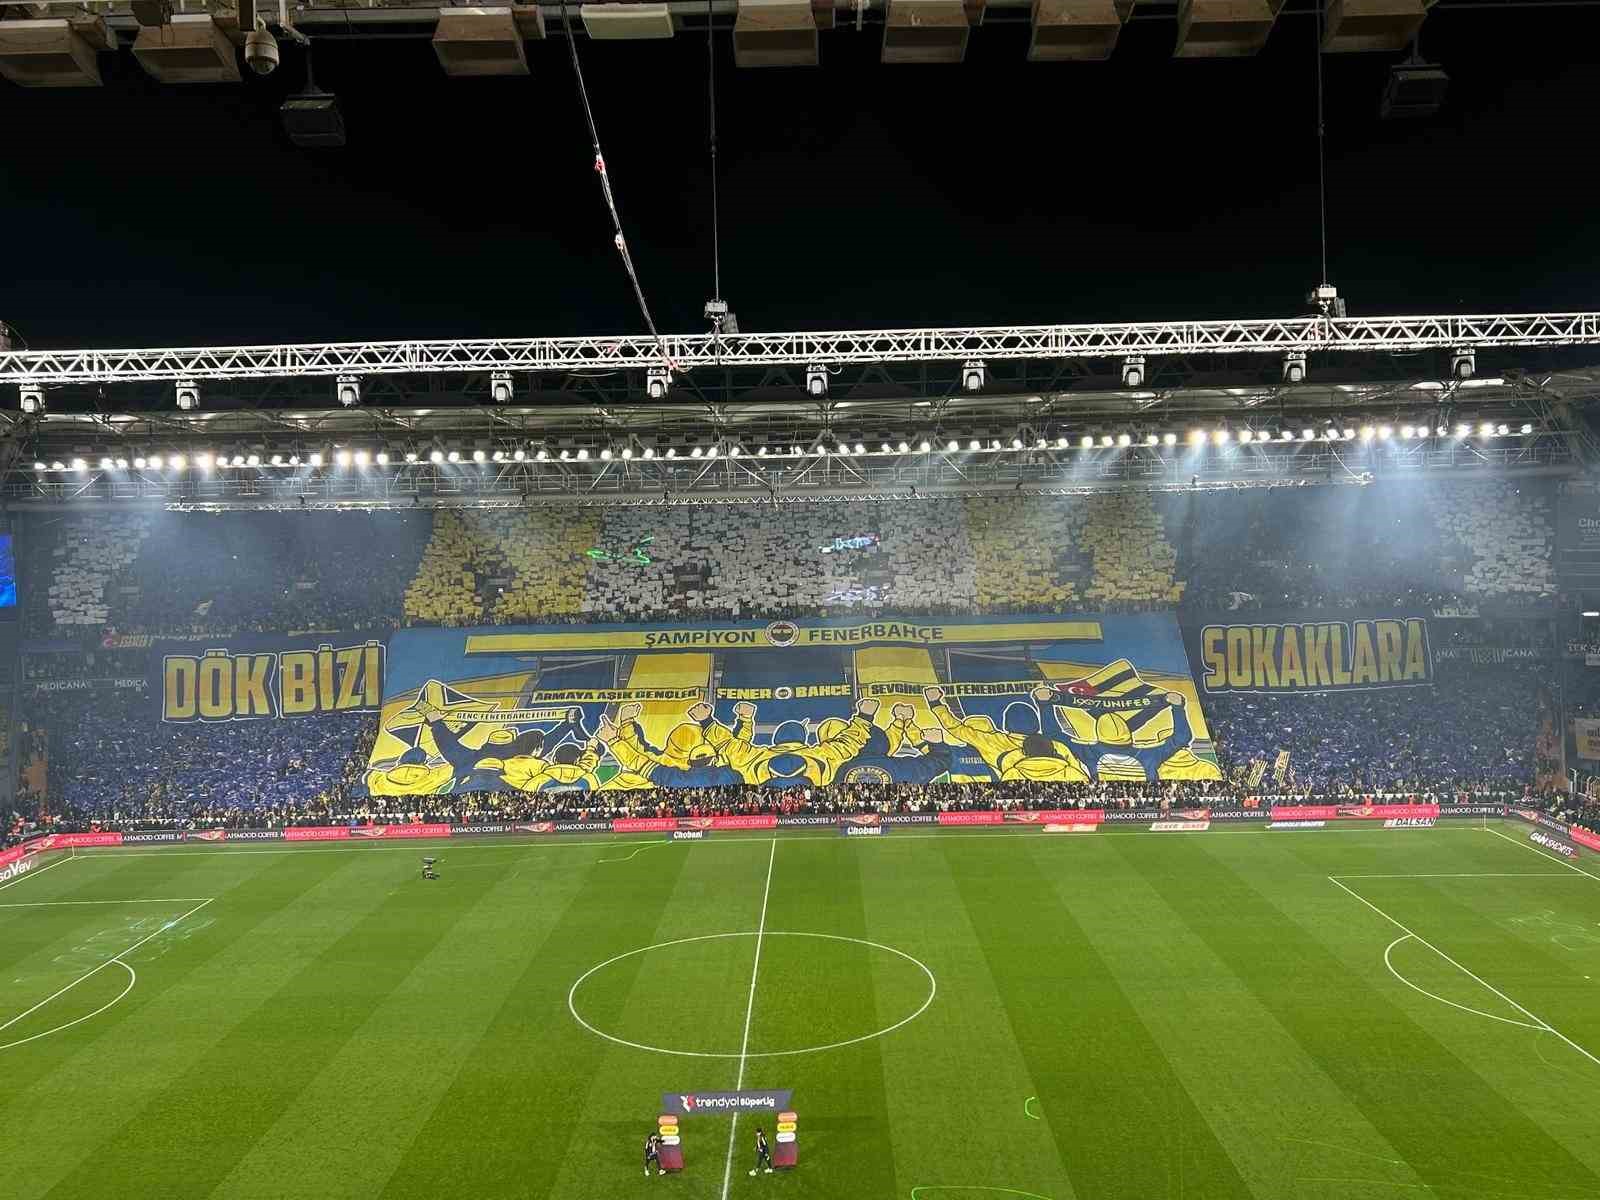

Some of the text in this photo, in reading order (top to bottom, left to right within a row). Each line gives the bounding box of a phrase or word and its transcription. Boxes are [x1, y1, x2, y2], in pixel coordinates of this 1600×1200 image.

[645, 630, 756, 647] ŞAMPİYON
[808, 624, 944, 642] FENERBAHÇE
[1202, 619, 1430, 690] SOKAKLARA
[164, 641, 383, 721] DÖK BİZİ
[716, 688, 772, 700] FENER
[673, 830, 703, 840] Chobani
[847, 826, 881, 835] Chobani
[696, 1095, 740, 1108] trendyol
